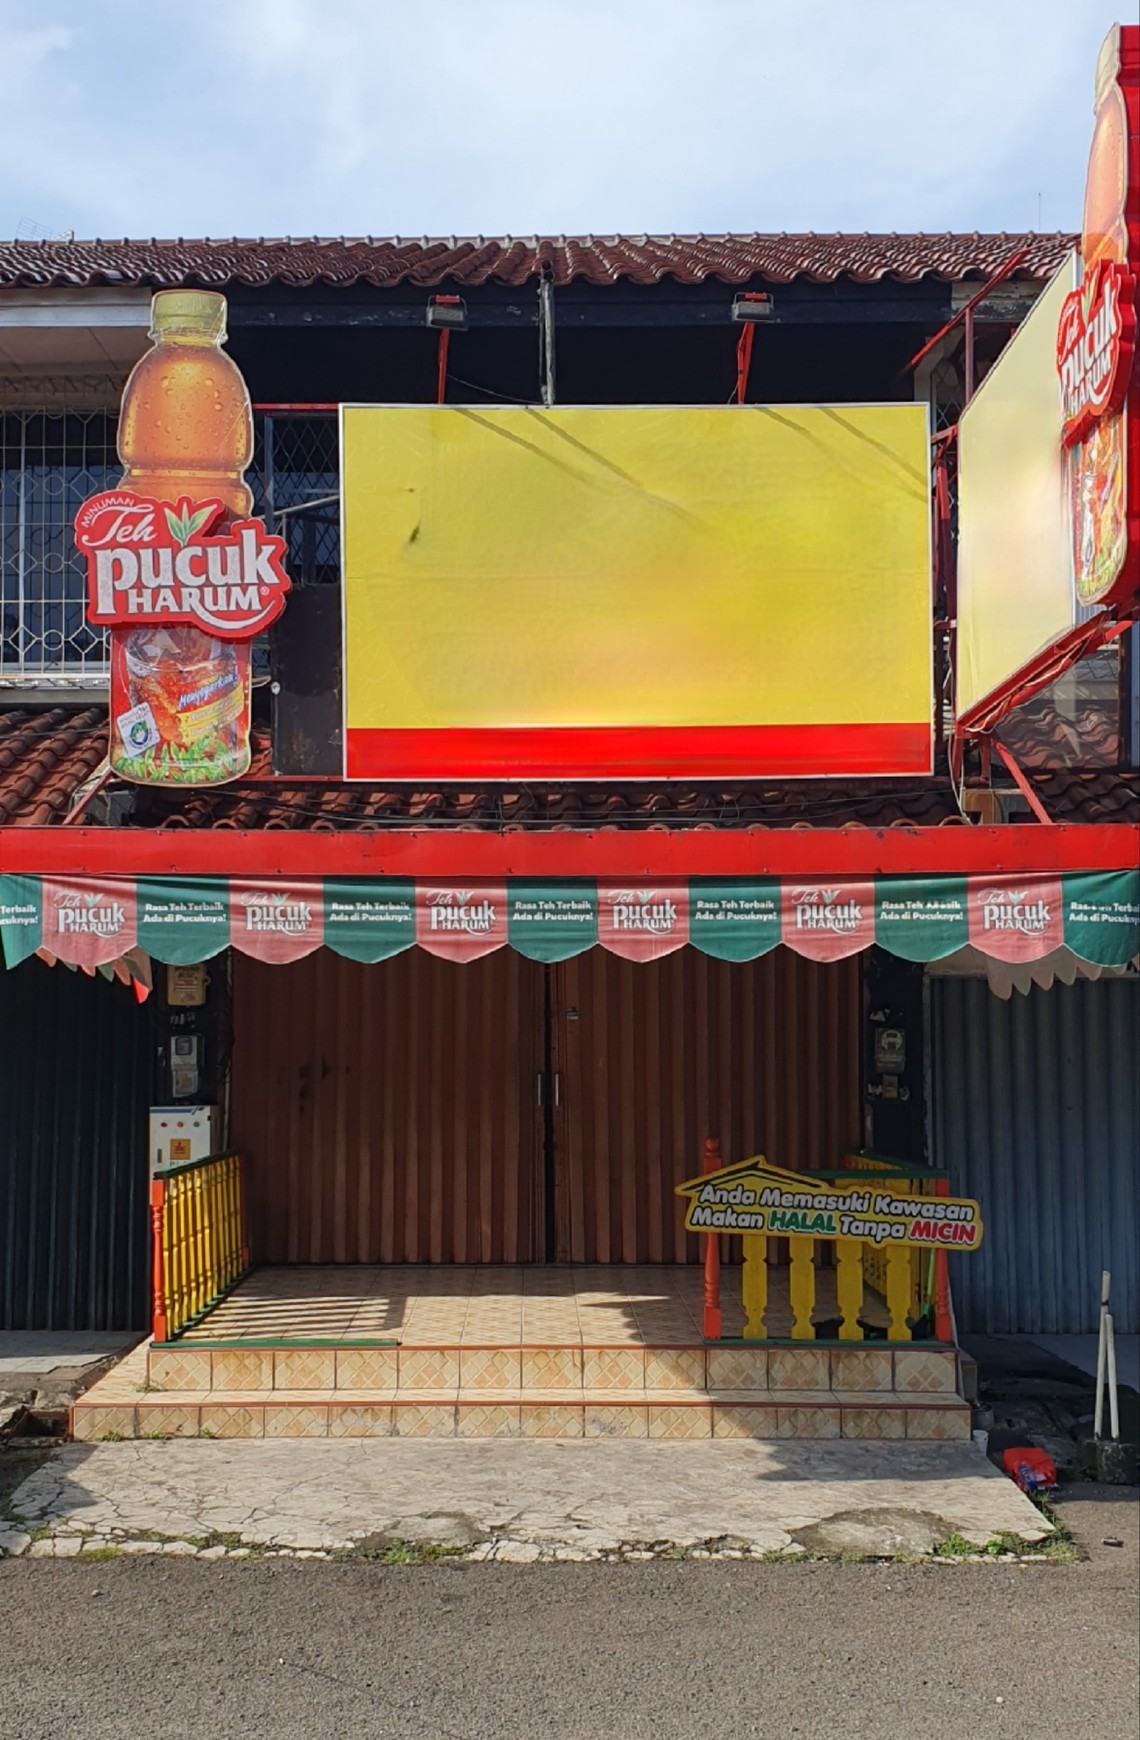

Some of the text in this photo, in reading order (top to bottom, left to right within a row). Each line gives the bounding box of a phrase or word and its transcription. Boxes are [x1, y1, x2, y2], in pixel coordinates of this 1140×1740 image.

[81, 497, 135, 527] MINUMAN
[81, 504, 158, 546] Teh
[95, 528, 280, 615] pucuk
[128, 585, 270, 624] HARUM
[53, 890, 82, 908] Teh
[240, 892, 269, 906] Teh
[426, 891, 453, 906] Teh
[607, 890, 634, 904] Teh
[791, 889, 819, 903] Teh
[977, 890, 1006, 905] Teh
[0, 904, 37, 914] Terbaik
[145, 902, 224, 911] Rasa Teh Terbaik
[332, 902, 410, 910] Rasa Teh Terbaik
[515, 901, 591, 909] Rasa Teh Terbaik
[696, 900, 774, 909] Rasa Teh Terbaik
[882, 901, 905, 909] Rasa
[906, 901, 923, 909] Teh
[58, 902, 126, 933] pucuk
[143, 914, 226, 924] Ada di Pucuknya!
[245, 902, 312, 931] pucuk
[330, 912, 412, 922] Ada di Pucuknya!
[430, 900, 497, 930] pucuk
[513, 912, 594, 922] Ada di Pucuknya!
[612, 899, 678, 929] pucuk
[695, 911, 778, 922] Ada di Pucuknya!
[796, 899, 863, 929] pucuk
[880, 912, 963, 922] Ada di Pucuknya!
[983, 899, 1051, 930] pucuk
[1069, 913, 1089, 922] Ada
[1090, 913, 1100, 922] di
[70, 922, 121, 936] HARUM
[257, 921, 309, 934] HARUM
[442, 921, 494, 934] HARUM
[623, 919, 674, 933] HARUM
[807, 919, 859, 933] HARUM
[994, 919, 1048, 934] HARUM
[699, 1184, 973, 1221] Anda Memasuki Kawasan
[691, 1207, 977, 1244] Makan HALAL Tanpa MICIN
